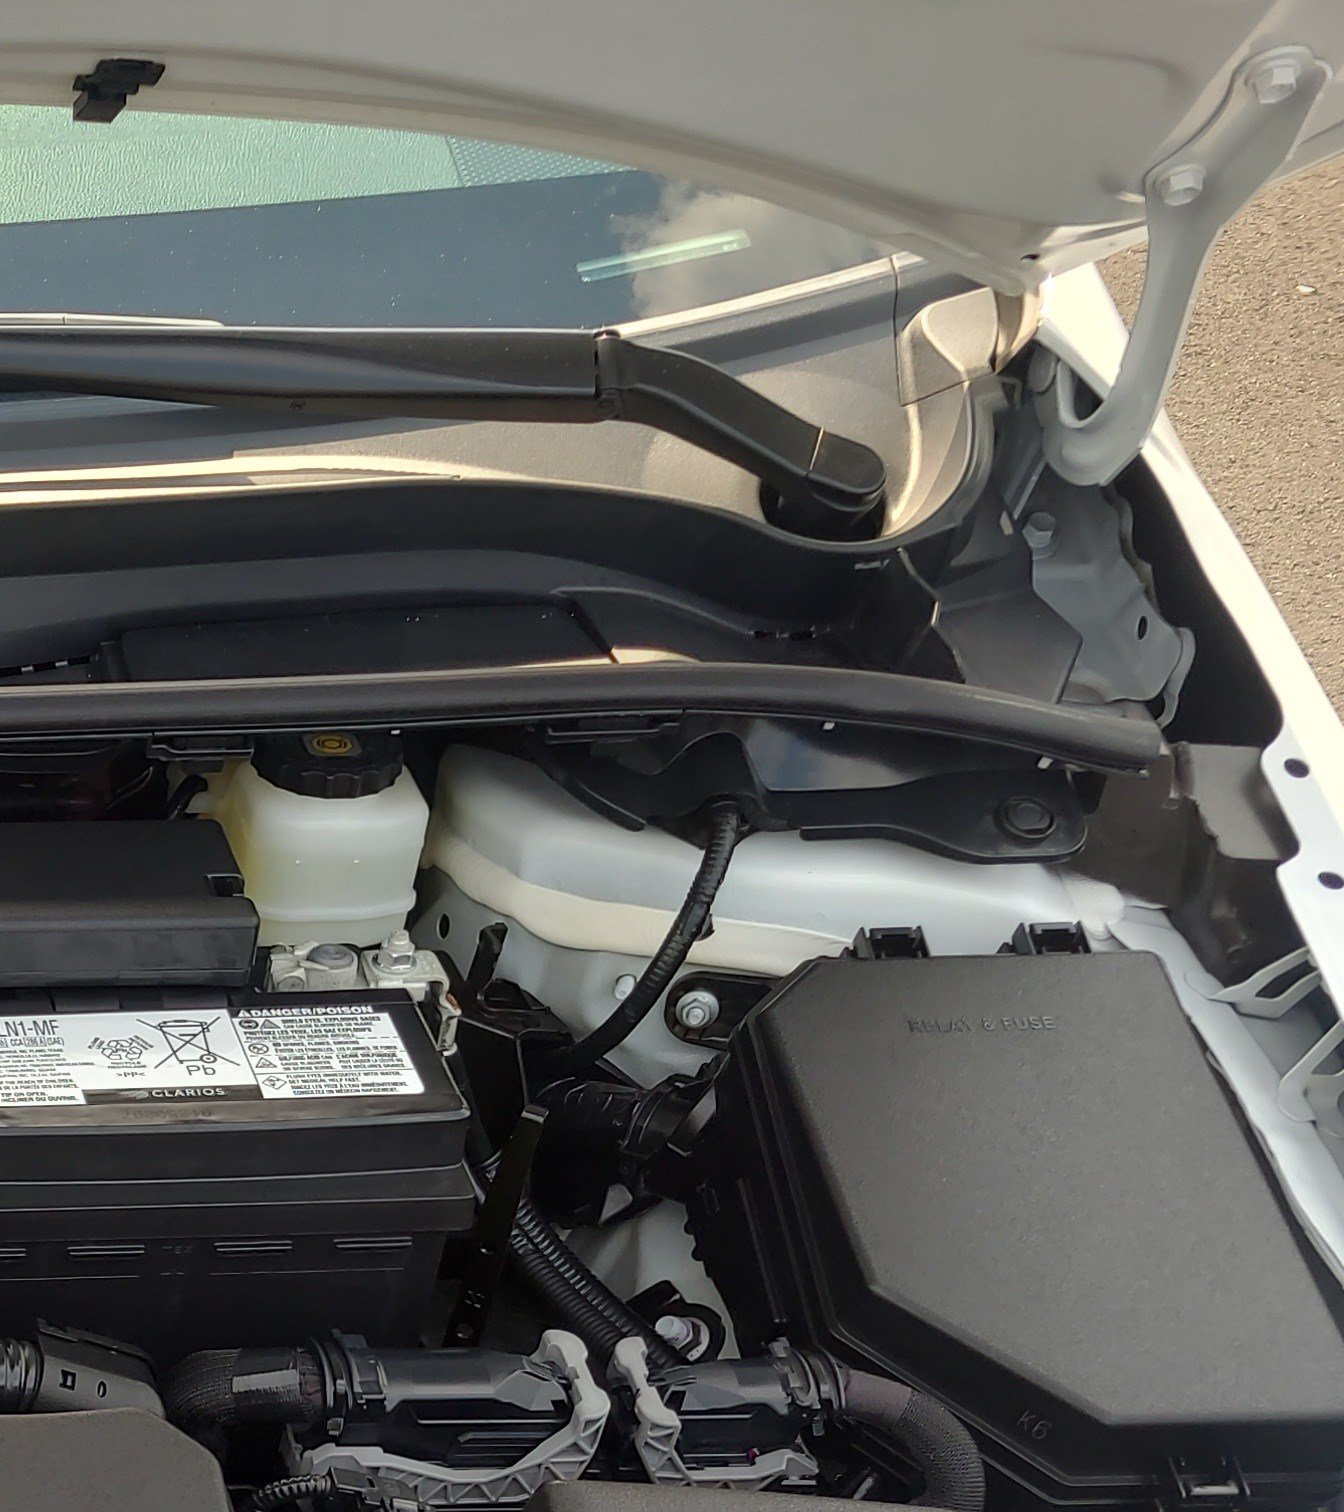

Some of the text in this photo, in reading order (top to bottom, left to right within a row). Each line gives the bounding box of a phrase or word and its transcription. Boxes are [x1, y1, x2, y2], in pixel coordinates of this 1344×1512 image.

[250, 1006, 373, 1017] DANGER/POISON
[1000, 1016, 1056, 1031] FUSE
[10, 1038, 23, 1046] CCA
[46, 1036, 64, 1046] (SAE)
[186, 1065, 216, 1076] Pb
[151, 1087, 225, 1098] CLARIOS
[1016, 1408, 1053, 1441] K6
